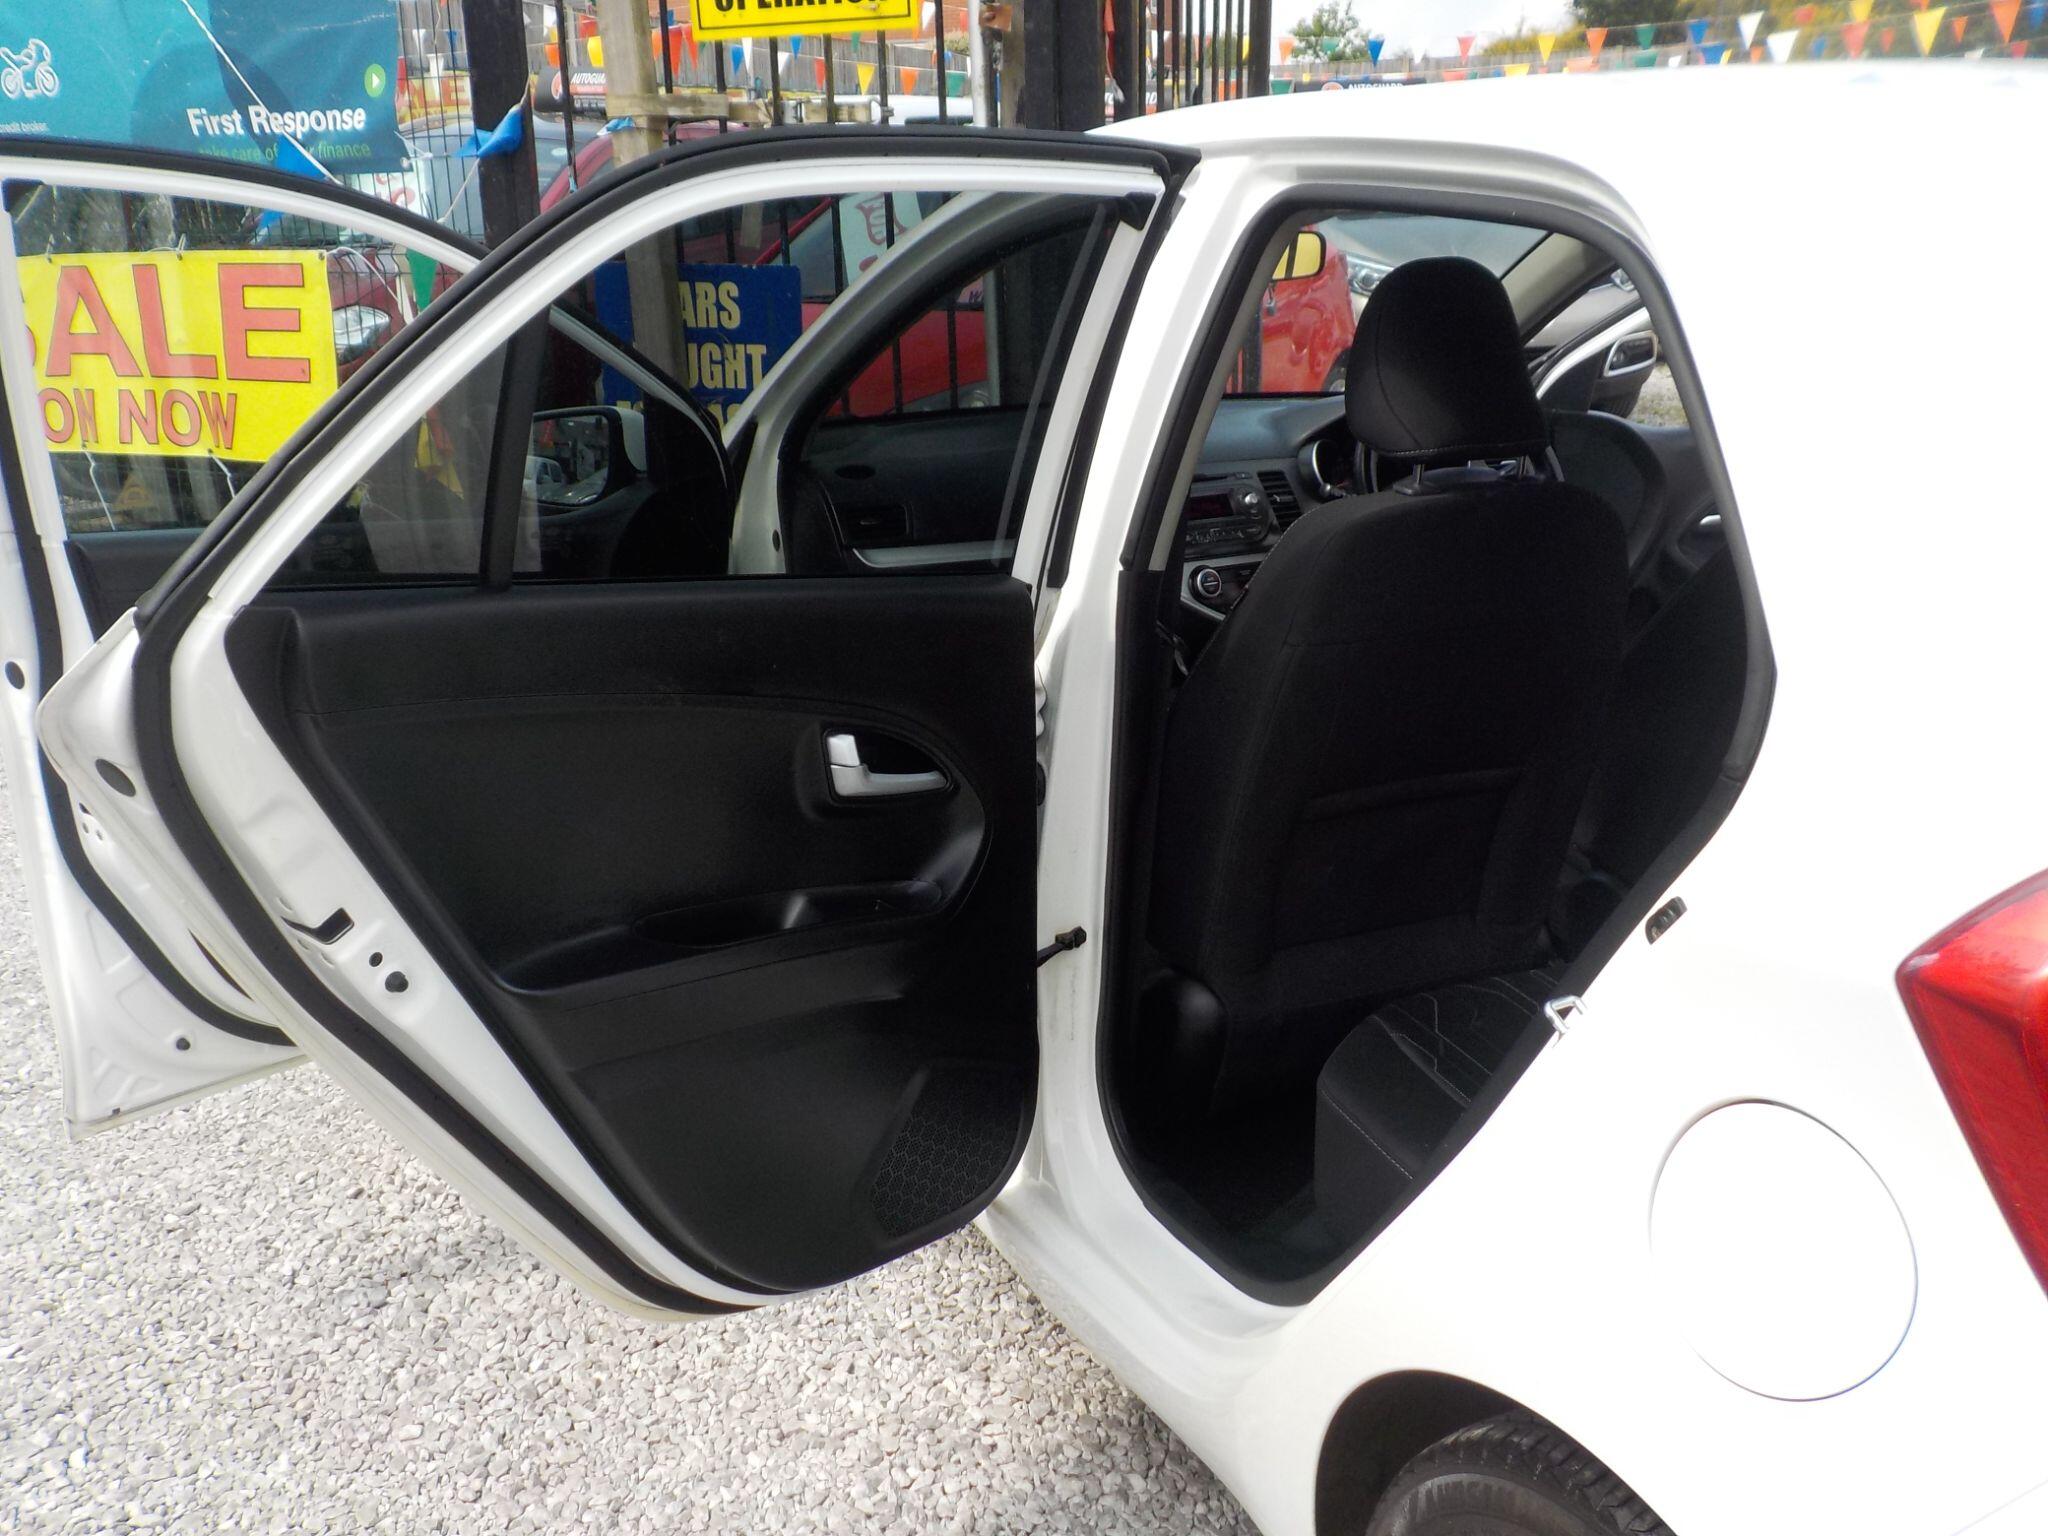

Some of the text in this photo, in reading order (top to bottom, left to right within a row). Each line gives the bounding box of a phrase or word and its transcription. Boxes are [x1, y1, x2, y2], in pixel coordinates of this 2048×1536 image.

[186, 108, 245, 137] First
[248, 104, 366, 138] Response
[264, 143, 279, 161] of
[318, 141, 373, 162] finance
[24, 262, 311, 383] ALE
[678, 281, 741, 330] ARS
[38, 388, 237, 450] ON NOW
